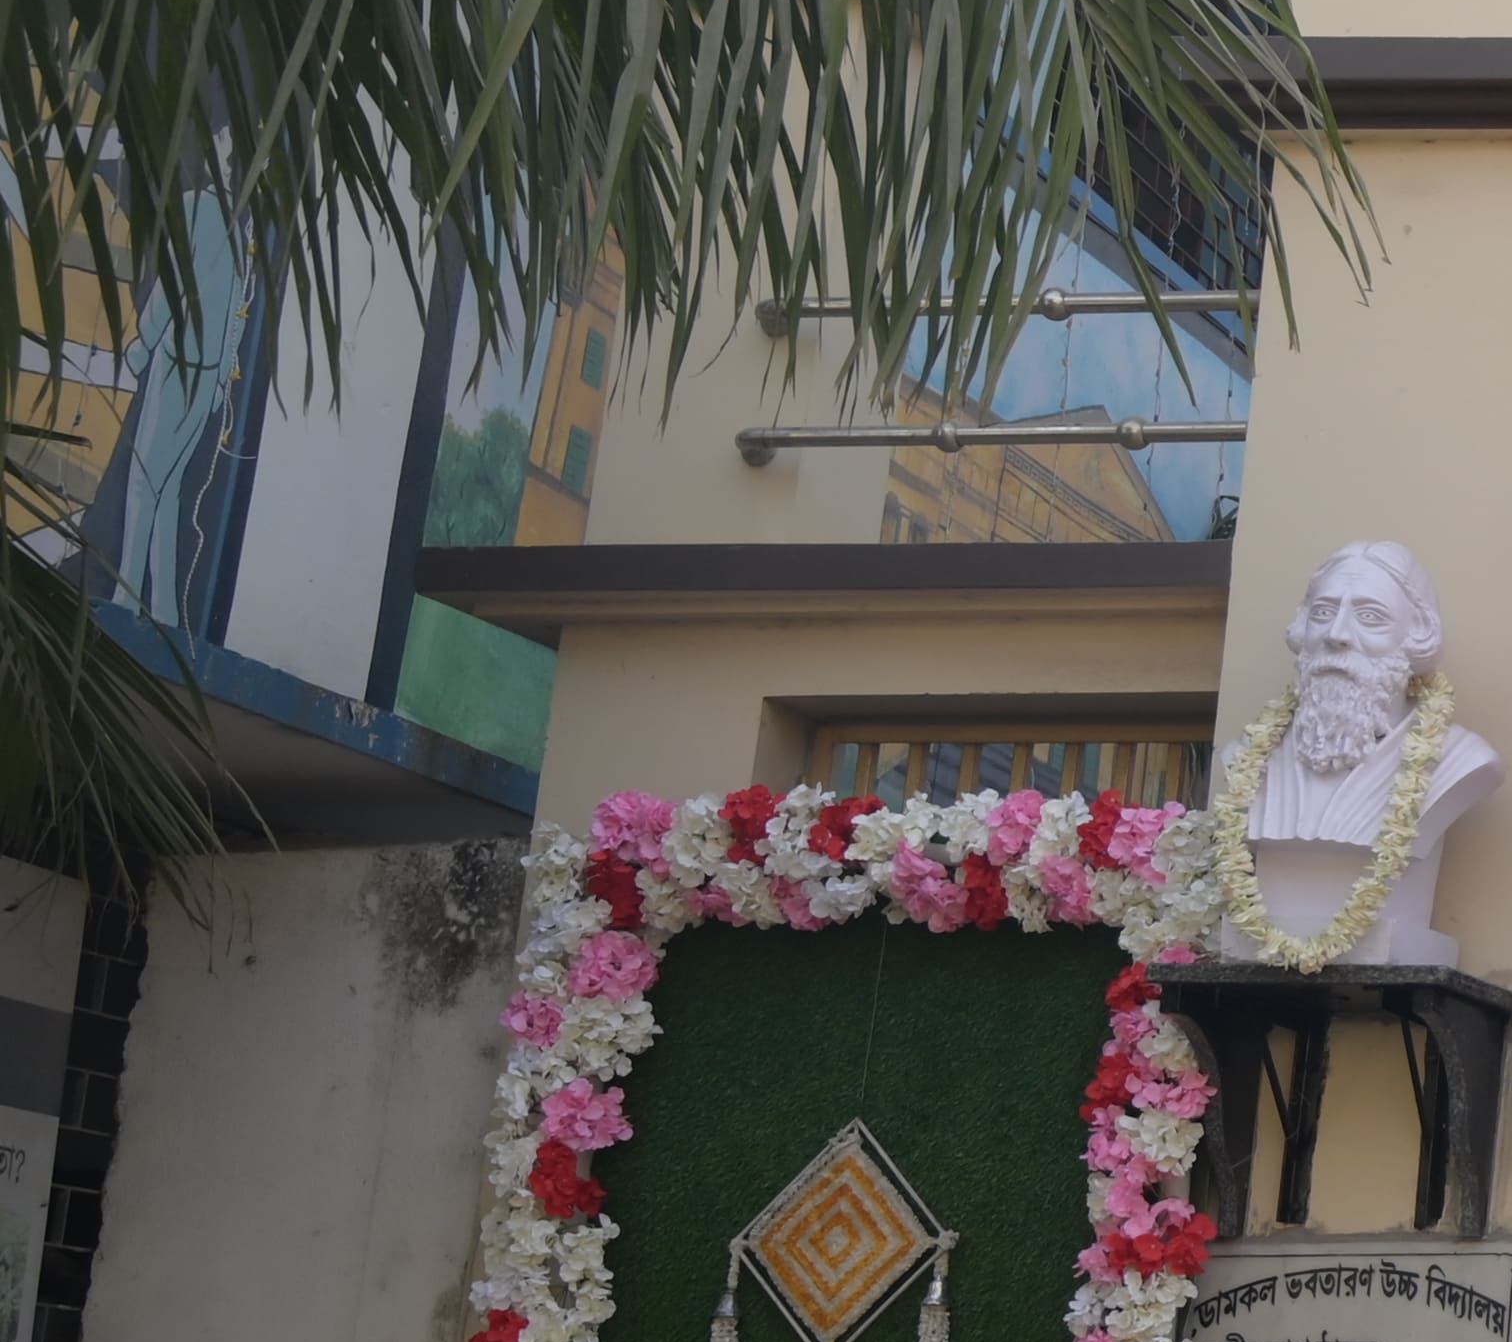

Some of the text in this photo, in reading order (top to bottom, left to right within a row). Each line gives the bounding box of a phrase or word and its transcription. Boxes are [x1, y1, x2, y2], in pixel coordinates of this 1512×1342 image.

[1284, 1263, 1375, 1298] ভবতারণ
[1378, 1258, 1420, 1301] উচ্চ
[1424, 1264, 1506, 1338] বিদ্যালয়
